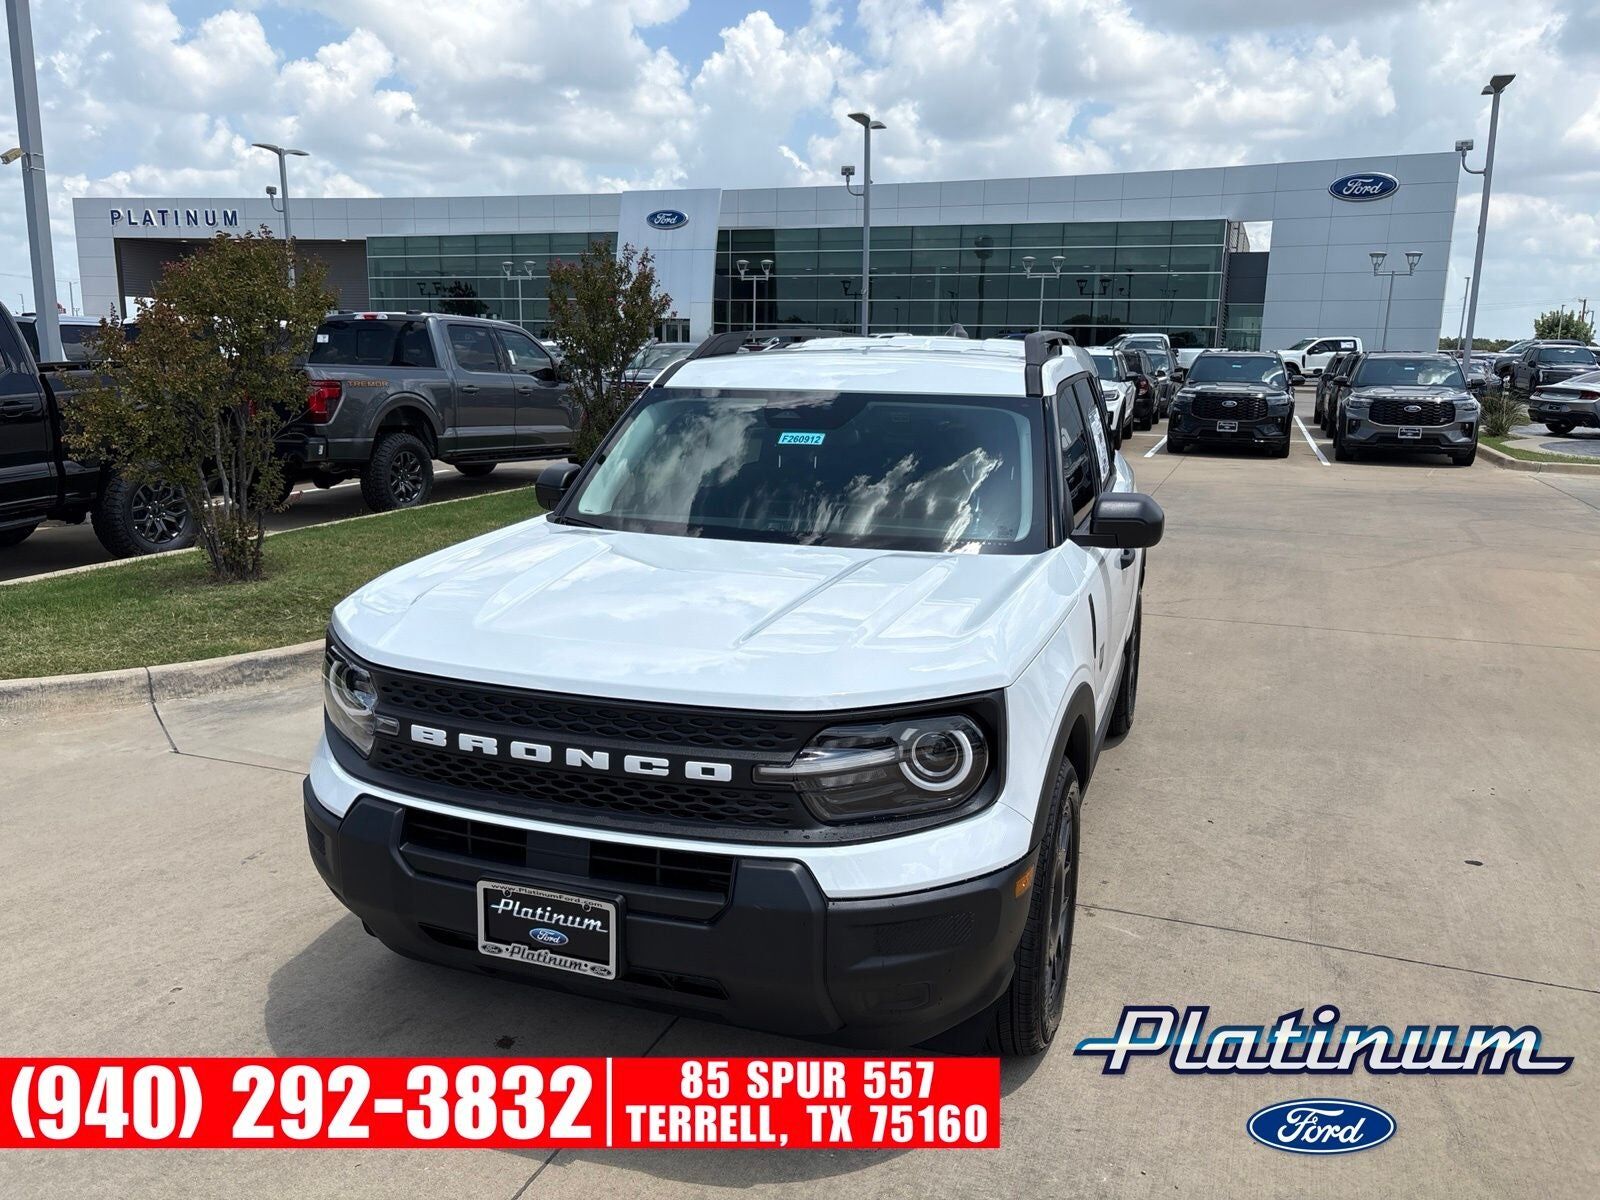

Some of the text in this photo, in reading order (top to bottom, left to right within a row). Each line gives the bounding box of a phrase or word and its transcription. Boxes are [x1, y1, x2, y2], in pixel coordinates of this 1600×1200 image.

[1342, 178, 1384, 195] Ford
[109, 208, 240, 227] PLATINUM
[781, 434, 822, 444] F260912
[410, 724, 733, 783] BRONCO
[490, 898, 609, 933] Platinum
[508, 943, 589, 973] Platinum
